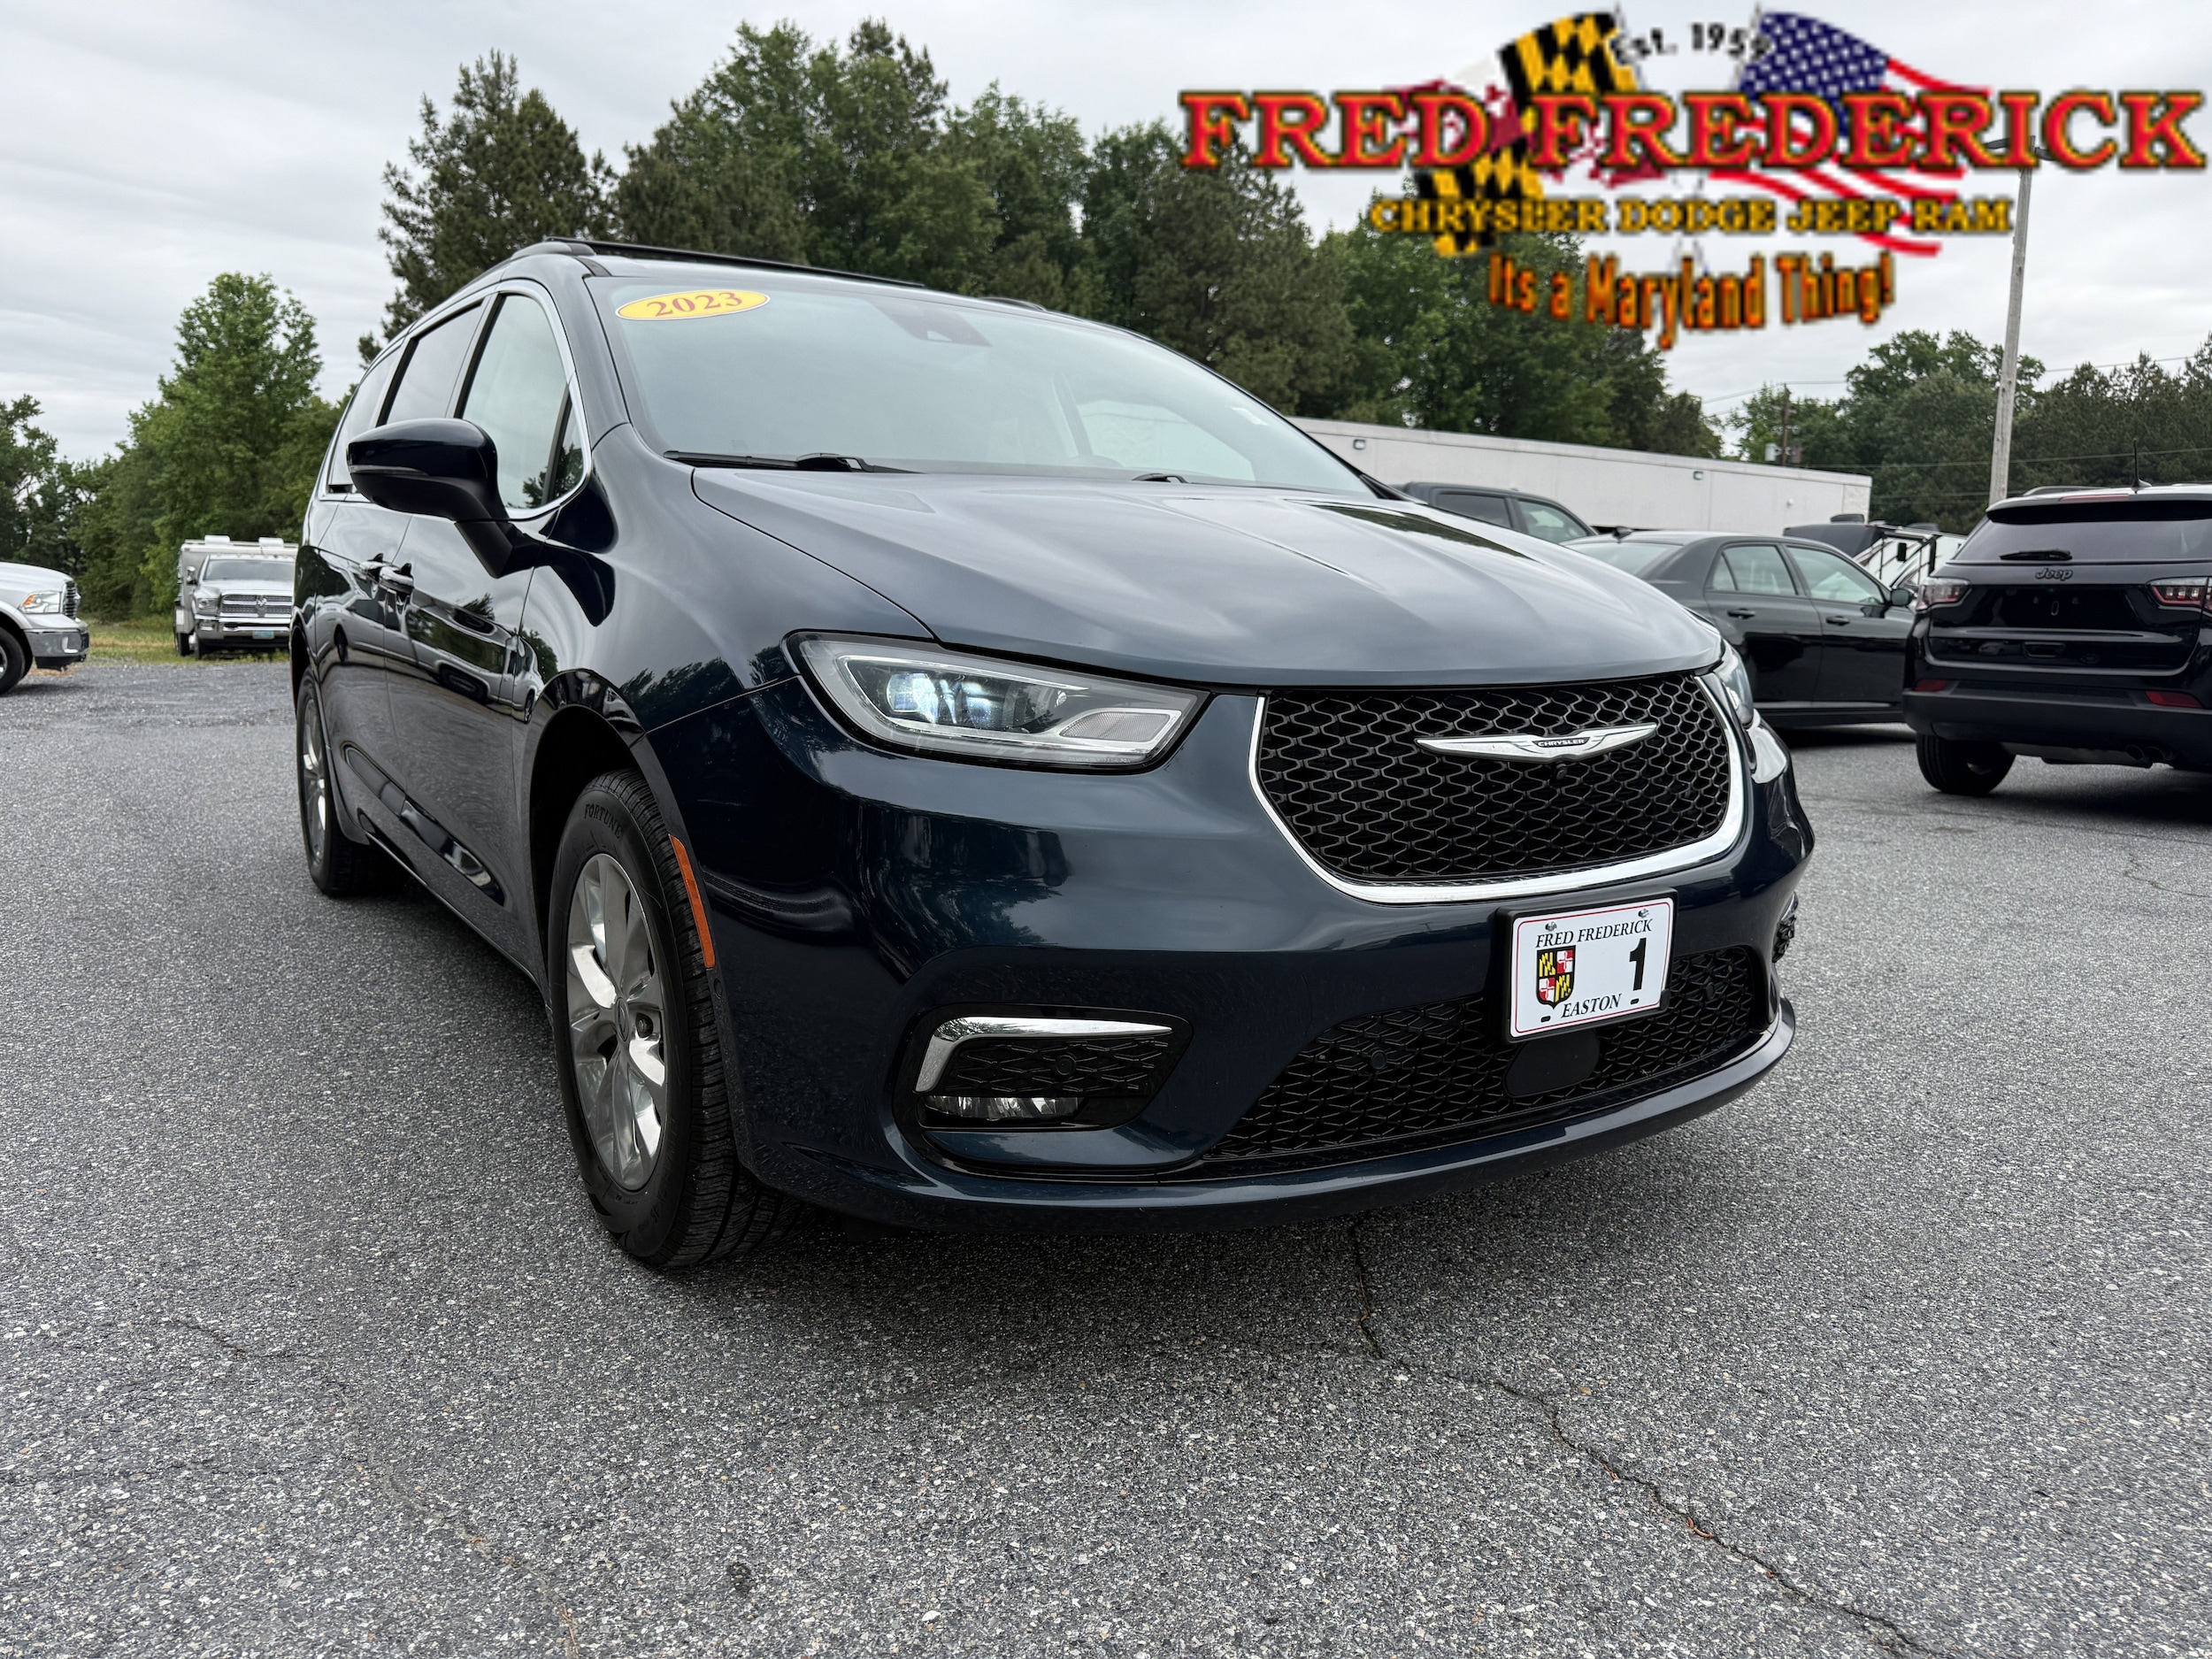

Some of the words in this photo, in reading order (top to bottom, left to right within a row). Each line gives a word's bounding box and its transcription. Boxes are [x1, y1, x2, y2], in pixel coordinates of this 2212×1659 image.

[647, 292, 742, 317] 2023
[2035, 567, 2073, 581] Jeep
[1537, 738, 1585, 747] CHRYSLER
[584, 803, 623, 839] FORTUNE
[1535, 931, 1574, 949] FRED
[1577, 918, 1653, 942] FREDERICK
[1629, 937, 1647, 991] 1
[1561, 994, 1623, 1018] EASTON
